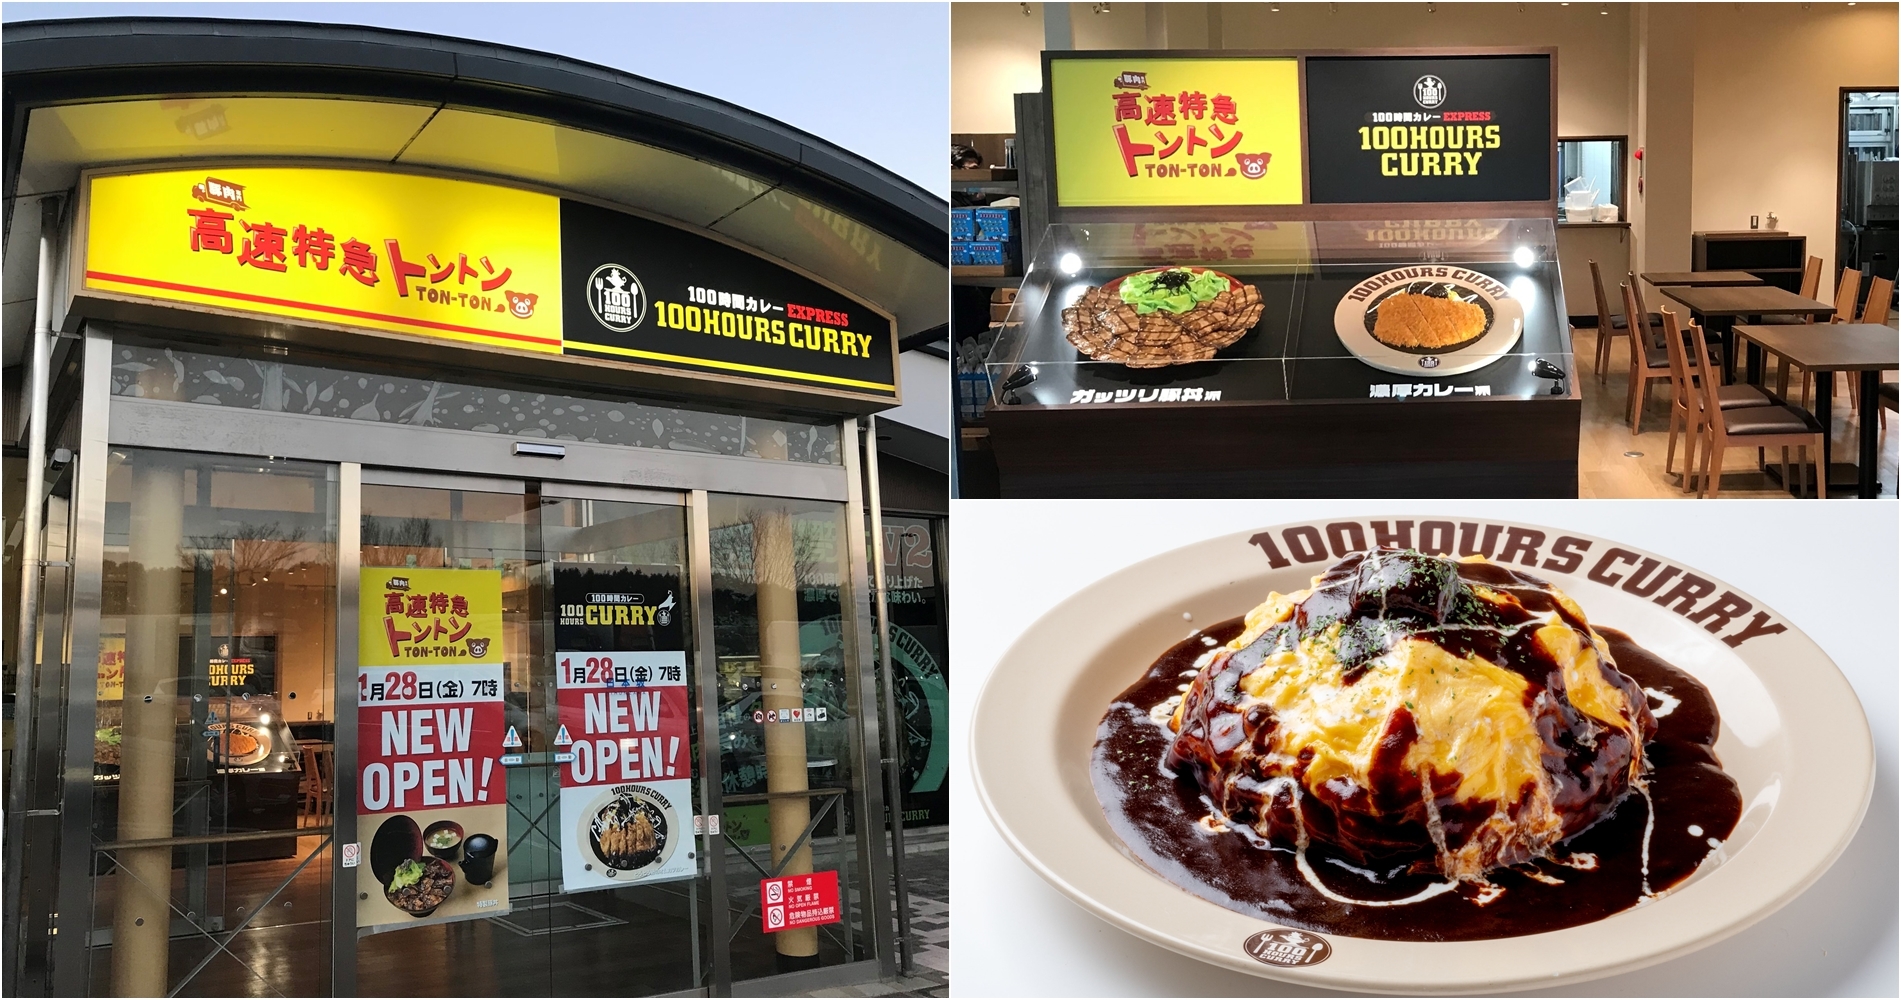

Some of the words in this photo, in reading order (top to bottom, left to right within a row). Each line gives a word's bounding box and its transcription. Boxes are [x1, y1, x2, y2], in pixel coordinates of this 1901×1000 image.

[1112, 91, 1239, 126] 高速特急
[1443, 111, 1491, 121] EXPRESS
[1358, 125, 1500, 150] 100HOURS
[1112, 123, 1243, 178] トントン
[1145, 163, 1222, 178] TON-TON
[1381, 152, 1482, 177] CURRY
[1348, 267, 1448, 302] 100HOURS
[1451, 270, 1510, 301] CURRY
[416, 285, 491, 312] TON-TON
[603, 290, 631, 308] 100
[604, 304, 632, 316] HOURS
[687, 286, 784, 314] 100時間カレー
[787, 303, 849, 326] EXPRESS
[604, 312, 632, 325] CURRY
[654, 301, 786, 346] 100HOURS
[789, 323, 872, 358] CURRY
[1369, 383, 1491, 398] 濃厚カレー派
[1248, 520, 1595, 572] 100HOURS
[1587, 547, 1788, 649] CURRY
[384, 592, 469, 618] 高速特急
[560, 604, 584, 617] 100
[585, 605, 657, 625] CURRY
[383, 616, 472, 657] トントン
[404, 646, 457, 658] TON-TON
[209, 675, 246, 686] URRY
[658, 665, 681, 682] 7時
[584, 691, 661, 734] NEW
[381, 707, 474, 756] NEW
[571, 736, 680, 784] OPEN!
[362, 757, 493, 811] OPEN!
[611, 785, 651, 796] 100HOURS
[650, 790, 673, 811] CURRY
[1259, 954, 1300, 965] CURRY
[1262, 949, 1304, 961] HOURS
[1267, 942, 1308, 956] 100
